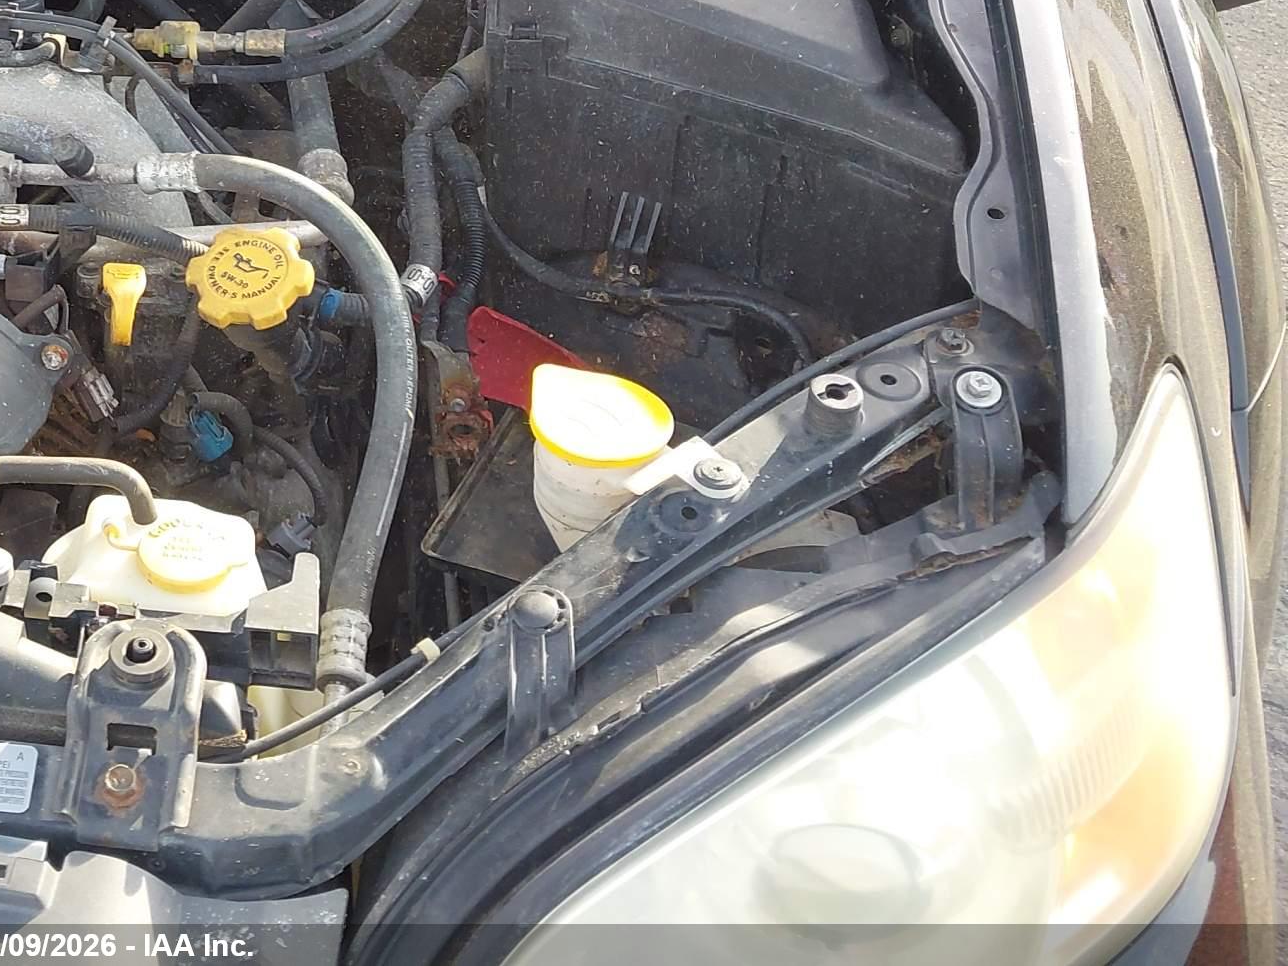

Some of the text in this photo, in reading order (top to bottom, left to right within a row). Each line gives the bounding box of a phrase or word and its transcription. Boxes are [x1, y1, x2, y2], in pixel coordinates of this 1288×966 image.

[234, 239, 284, 269] ENGINE OIL
[220, 271, 249, 289] 5W-30
[241, 276, 281, 299] MANUAL
[16, 751, 24, 762] A
